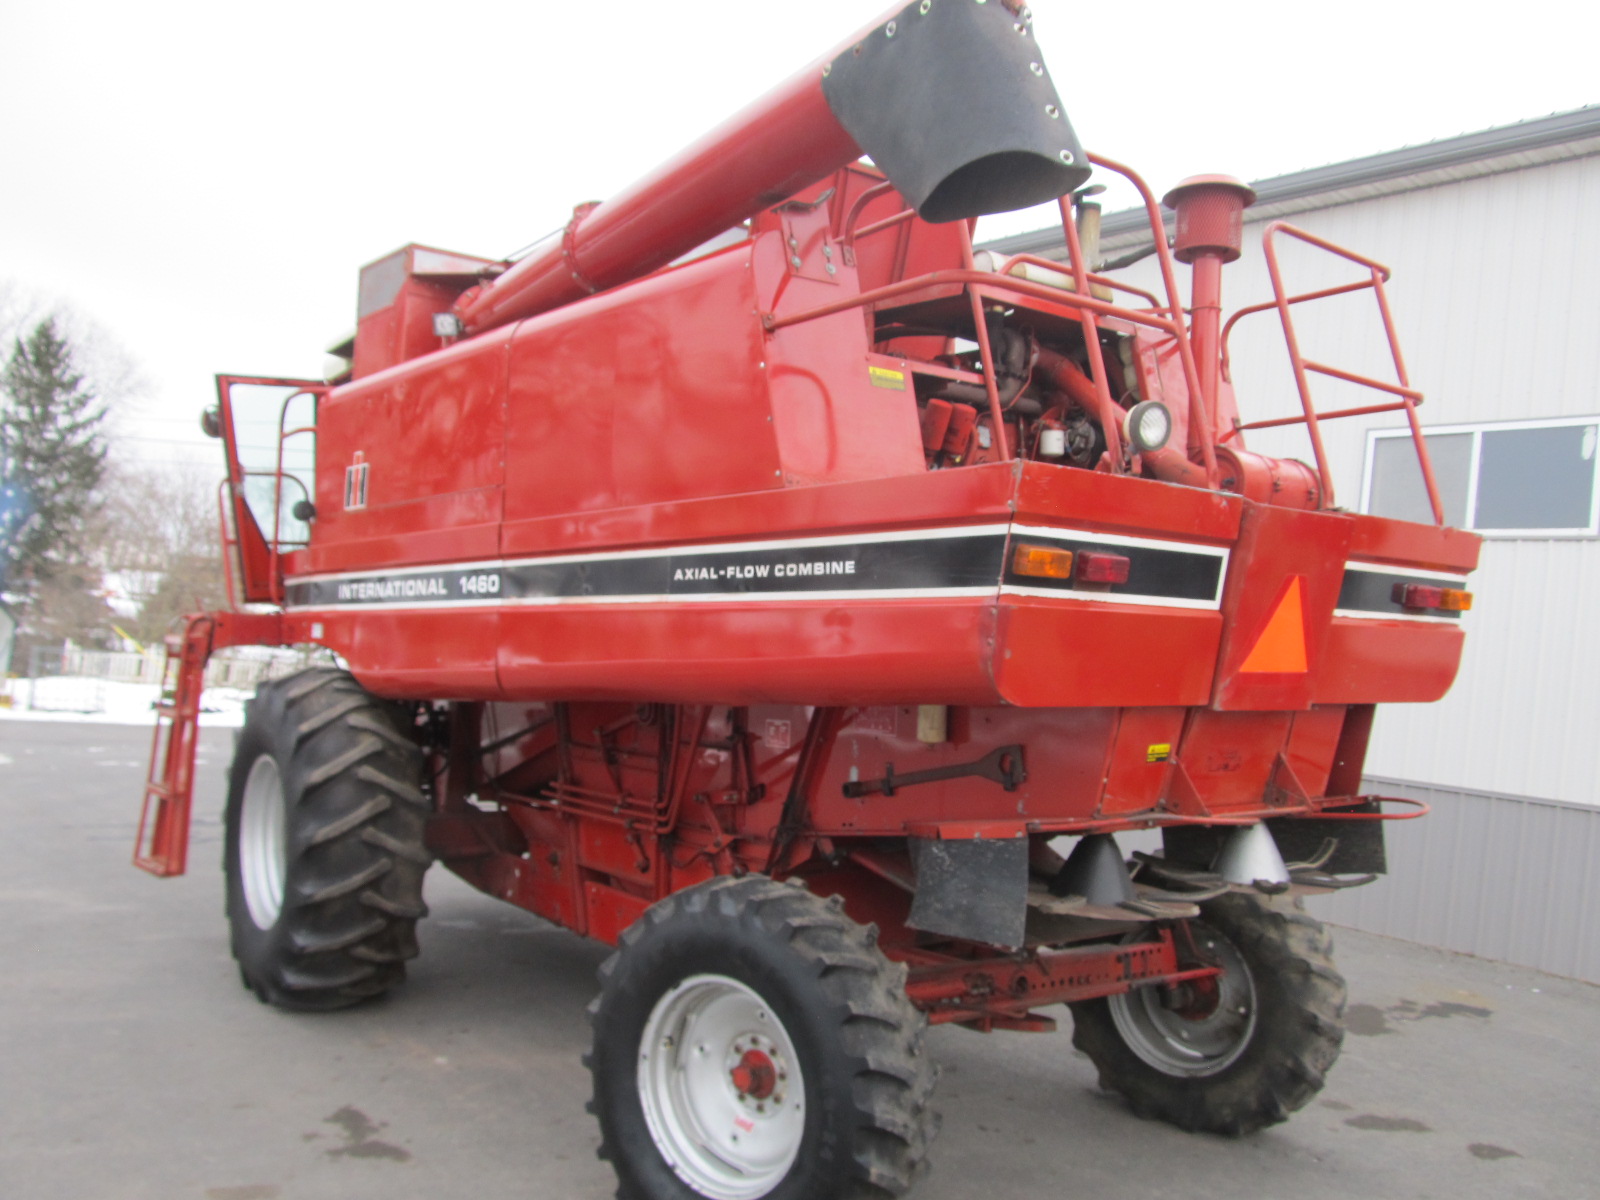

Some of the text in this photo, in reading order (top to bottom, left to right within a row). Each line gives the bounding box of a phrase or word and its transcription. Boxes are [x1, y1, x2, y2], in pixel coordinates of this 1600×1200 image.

[673, 560, 856, 581] AXIAL-FLOW COMBINE
[338, 574, 500, 599] INTERNATIONAL 1460
